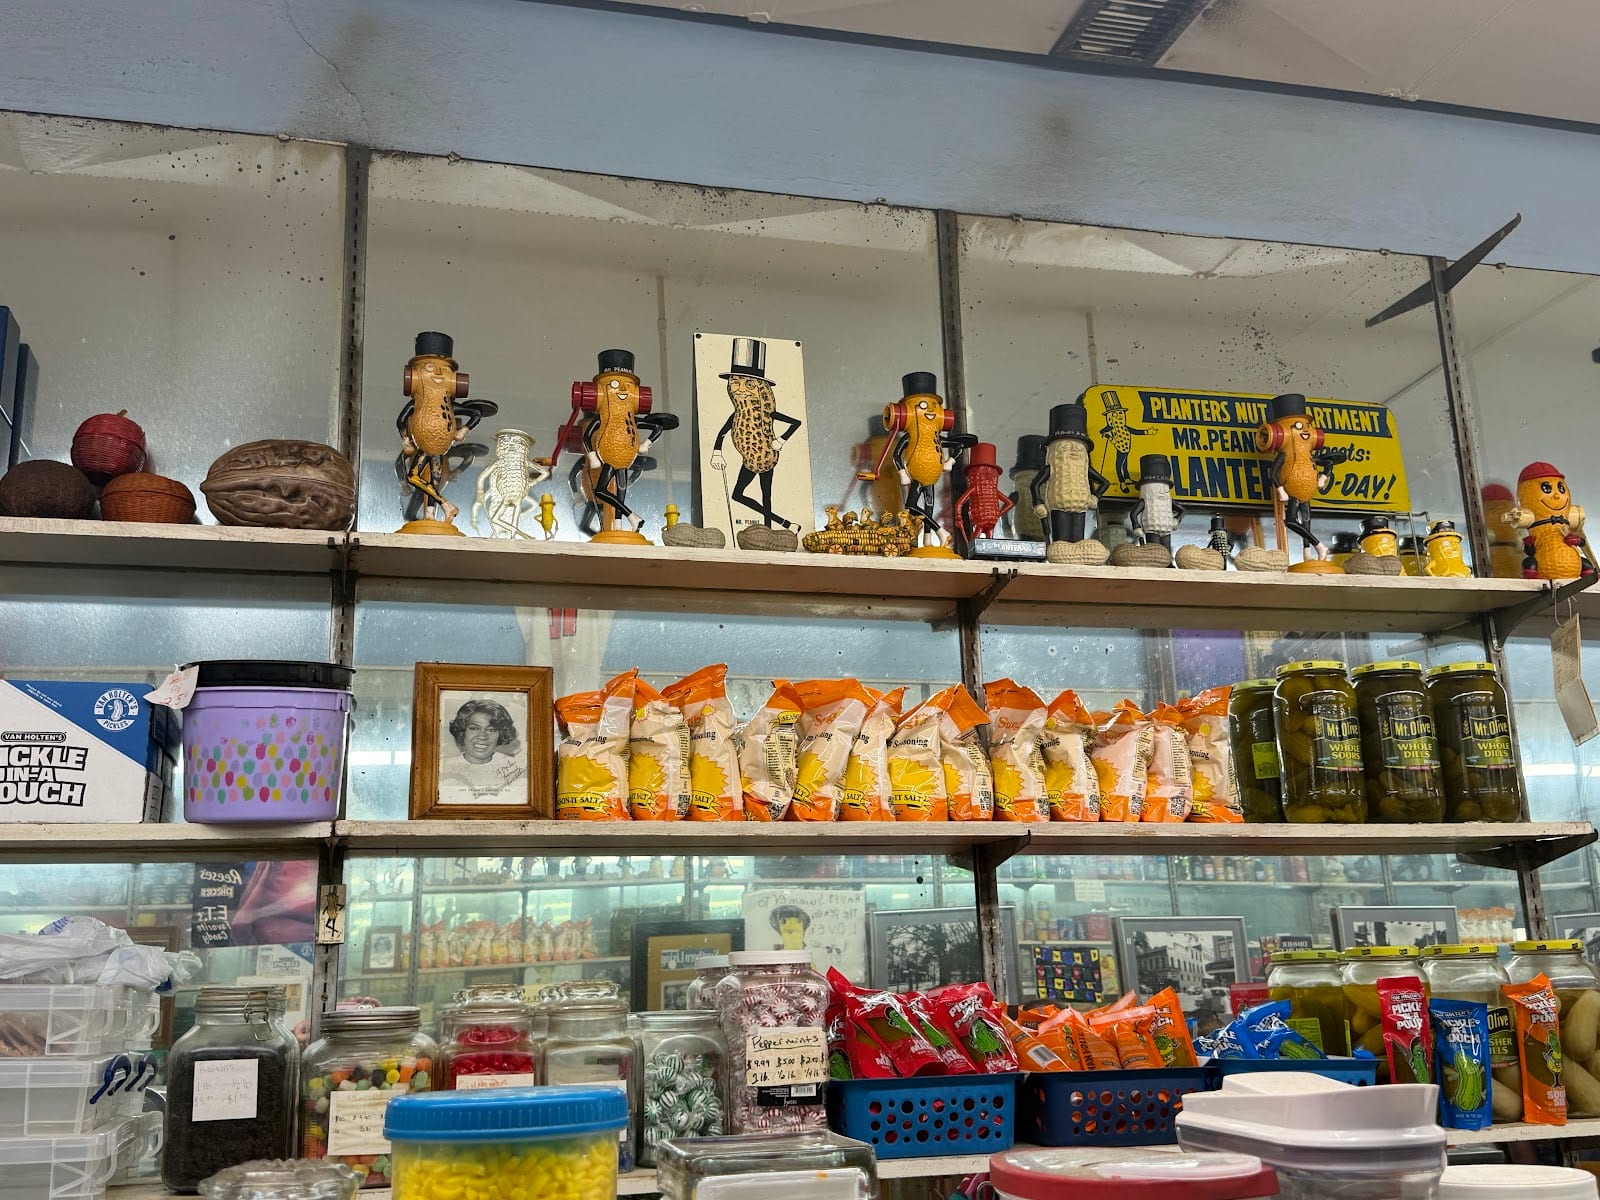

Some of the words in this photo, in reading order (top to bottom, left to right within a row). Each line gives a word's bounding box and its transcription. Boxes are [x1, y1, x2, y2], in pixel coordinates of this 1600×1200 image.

[1149, 396, 1231, 423] PLANTERS
[1234, 401, 1268, 424] NUT
[1305, 406, 1380, 433] ARTMENT
[102, 719, 130, 730] PICKLES
[1326, 722, 1341, 737] Mt.
[1341, 721, 1359, 737] Olive
[1394, 721, 1410, 737] Mt.
[1410, 720, 1431, 737] Olive
[1473, 721, 1489, 737] Mt.
[1488, 719, 1508, 736] Olive
[1328, 743, 1360, 753] WHOLE
[1397, 743, 1433, 752] WHOLE
[1477, 742, 1510, 751] WHOLE
[0, 745, 88, 771] ICKLE
[1331, 751, 1361, 760] SOURS
[1403, 750, 1431, 759] DILLS
[1484, 750, 1510, 758] DILLS
[0, 781, 87, 807] OUCH
[1487, 1012, 1509, 1031] Olive
[1488, 1037, 1513, 1047] SHER
[1489, 1046, 1509, 1055] ILLS
